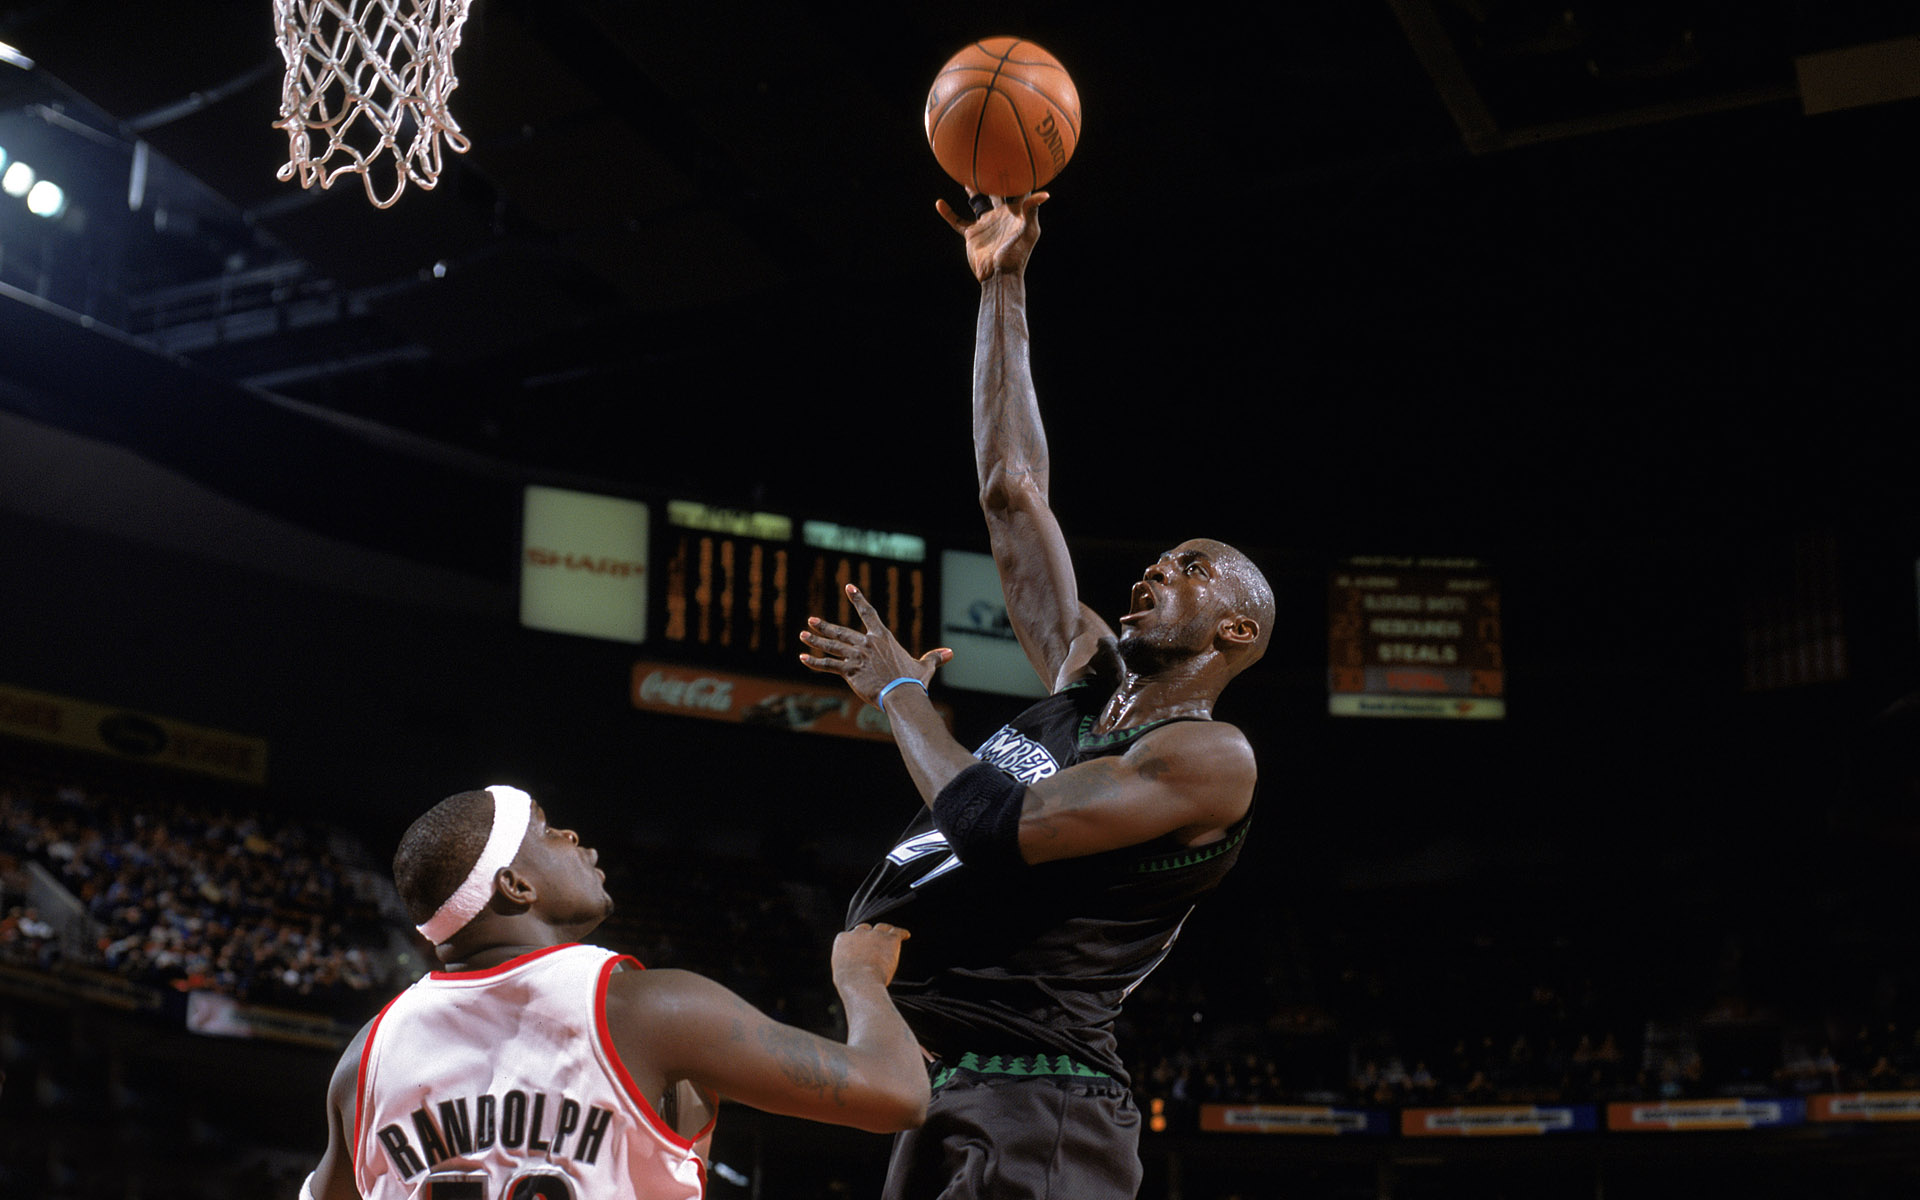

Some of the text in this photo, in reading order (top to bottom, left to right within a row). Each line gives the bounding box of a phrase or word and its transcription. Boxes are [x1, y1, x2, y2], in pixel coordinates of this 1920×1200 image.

[525, 547, 645, 578] SHARP
[1370, 619, 1462, 636] REBOUNDS
[1377, 644, 1457, 661] STEALS
[641, 671, 733, 712] Coca-Cola
[975, 725, 1060, 786] MBER
[377, 1090, 614, 1180] RANDOLPH
